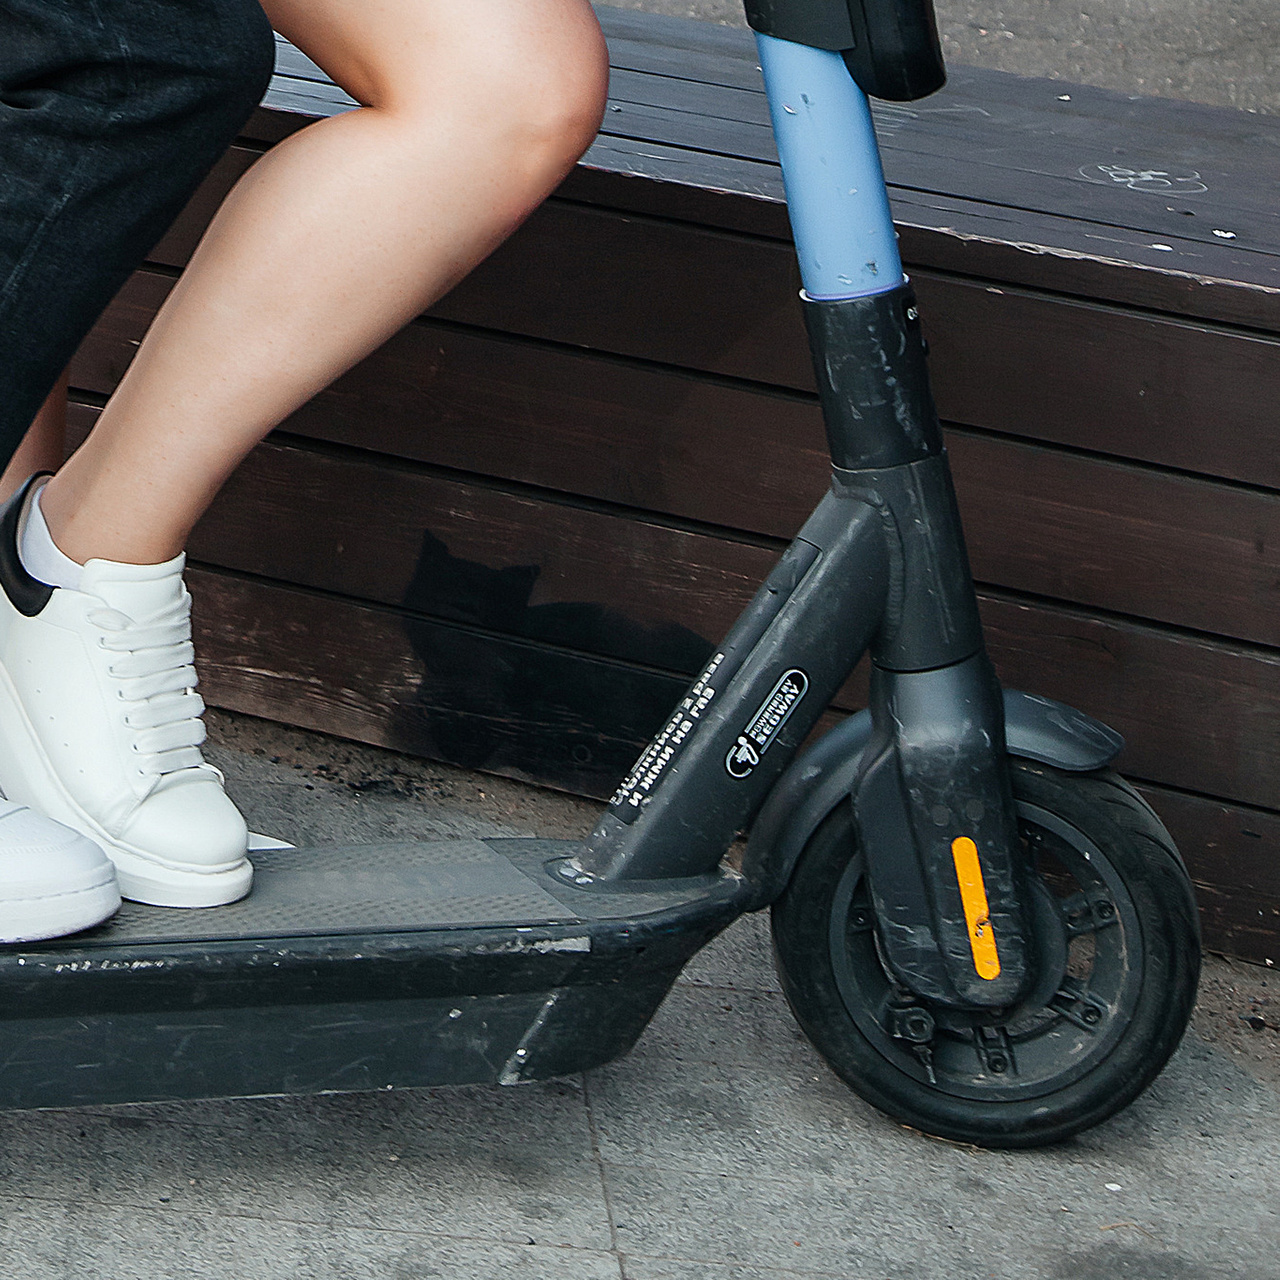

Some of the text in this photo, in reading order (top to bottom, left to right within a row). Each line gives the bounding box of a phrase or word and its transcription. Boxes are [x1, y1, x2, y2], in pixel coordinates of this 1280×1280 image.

[749, 693, 784, 740] POWERED
[755, 683, 800, 746] SEGWAY
[628, 687, 716, 807] и жми на газ
